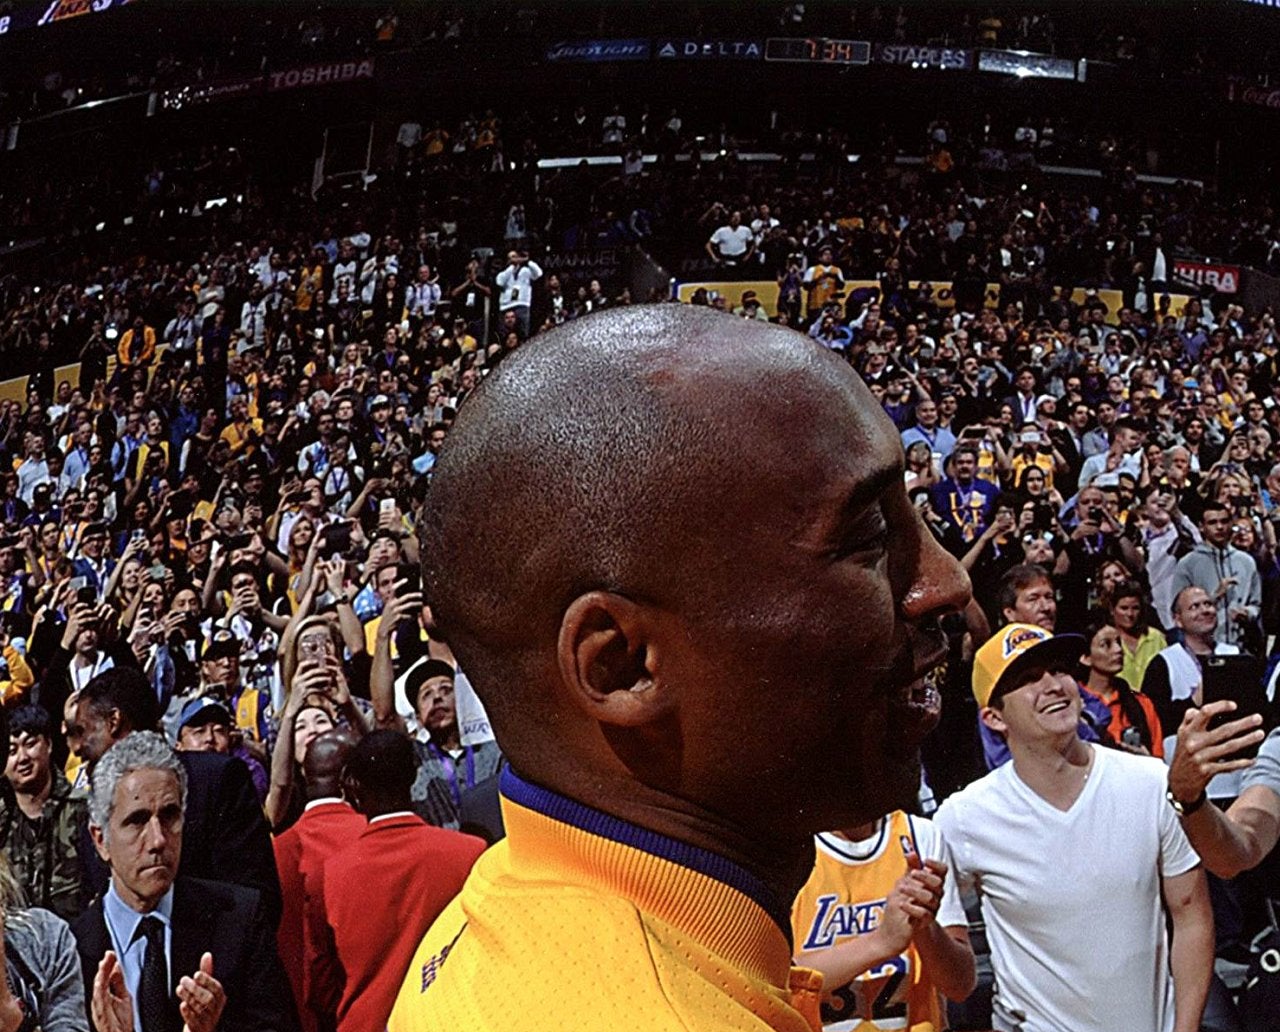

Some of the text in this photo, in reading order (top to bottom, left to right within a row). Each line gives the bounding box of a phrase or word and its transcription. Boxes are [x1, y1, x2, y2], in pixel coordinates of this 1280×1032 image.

[684, 42, 759, 56] DELTA
[882, 45, 965, 69] STAPLES
[271, 61, 374, 88] TOSHIBA
[1173, 266, 1237, 293] HIBA
[803, 894, 888, 950] LAKE
